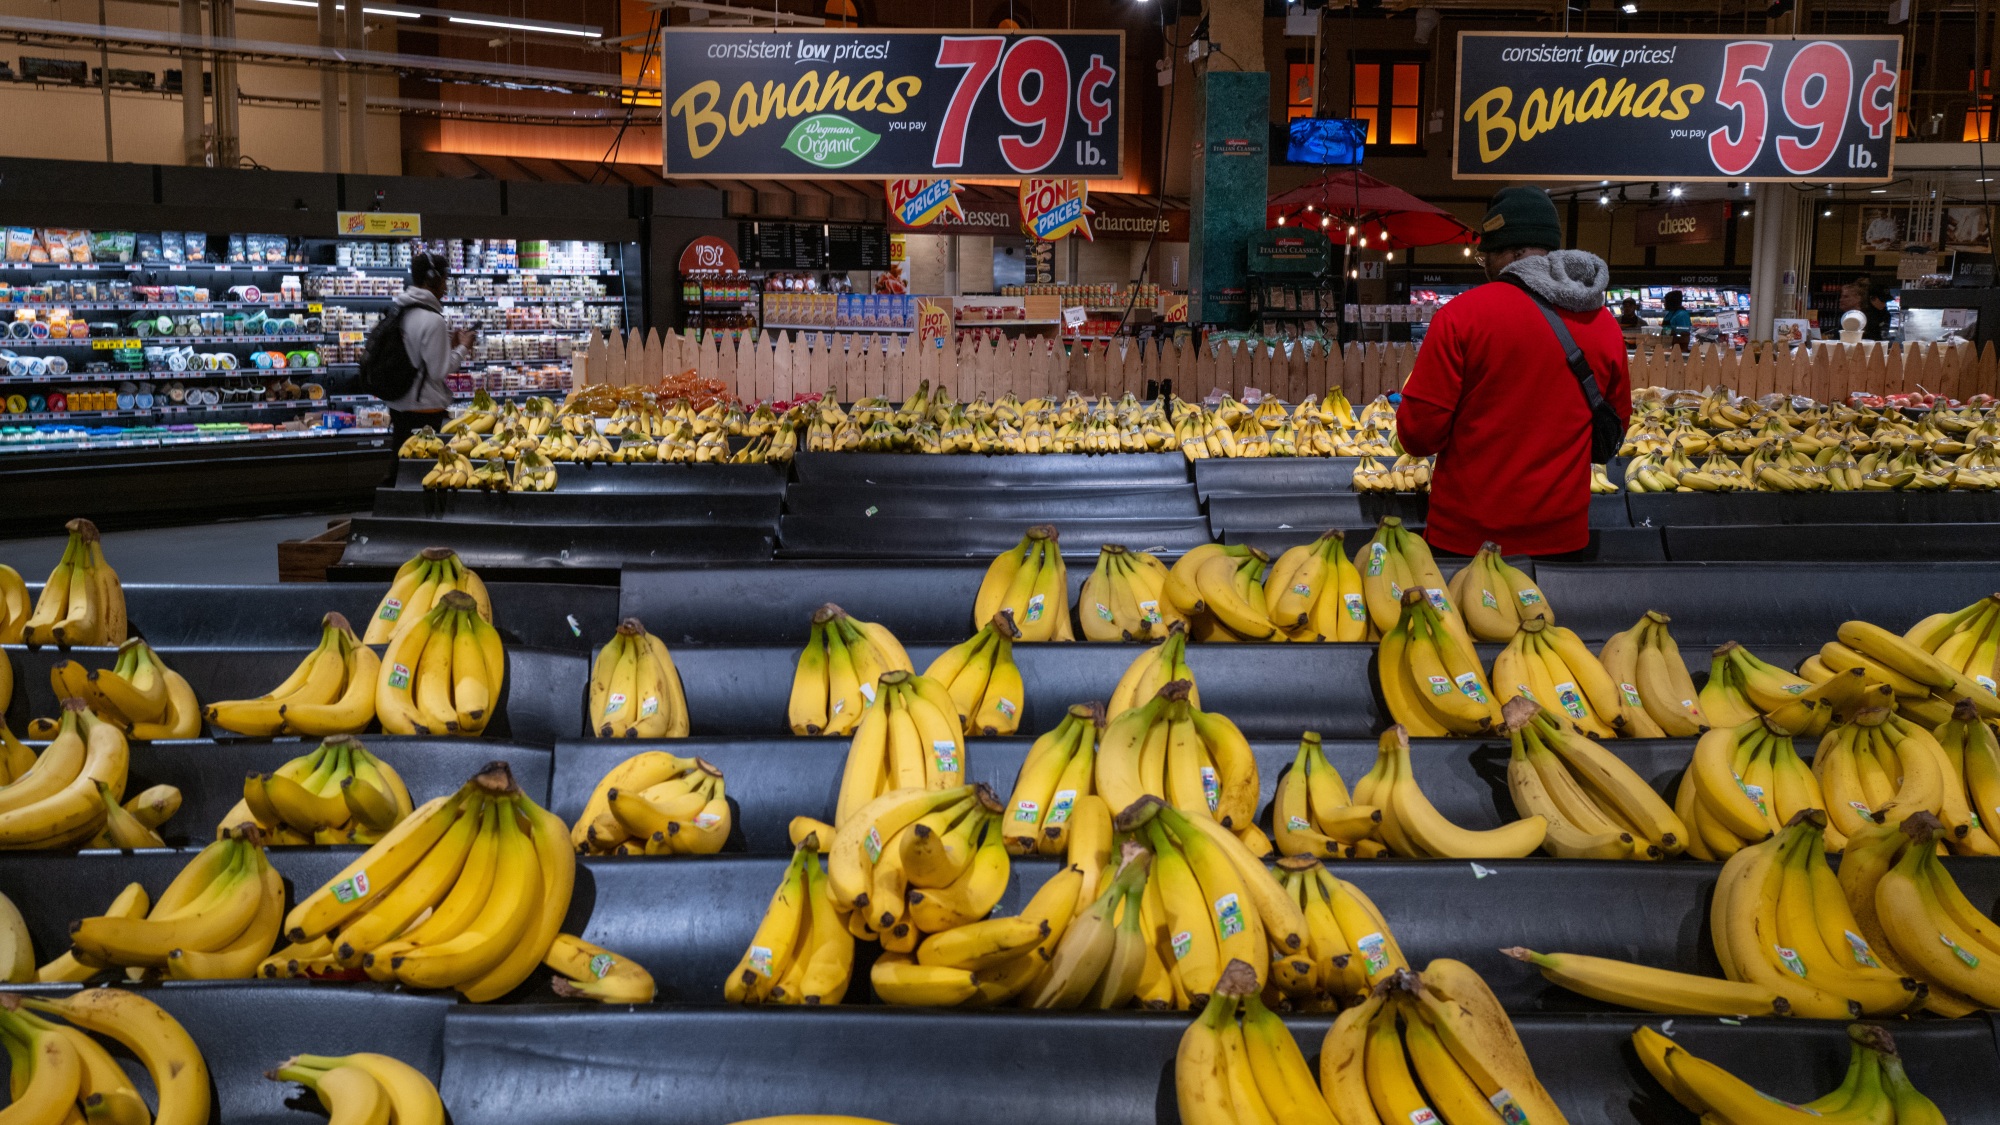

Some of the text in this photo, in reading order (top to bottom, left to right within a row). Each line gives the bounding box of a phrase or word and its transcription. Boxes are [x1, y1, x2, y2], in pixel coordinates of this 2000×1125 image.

[707, 39, 890, 64] consistent low prices!
[1501, 43, 1677, 68] consistent low prices!
[670, 69, 923, 160] Bananas
[888, 120, 927, 132] you pay
[1463, 77, 1706, 164] Bananas
[803, 121, 855, 137] Wegmans
[1670, 129, 1707, 140] you pay
[797, 134, 862, 161] Organic
[1075, 141, 1107, 166] lb.
[1848, 144, 1878, 169] lb.
[891, 179, 929, 213] ZO
[906, 179, 950, 221] PRICES
[1024, 179, 1079, 224] ZONE
[1039, 198, 1081, 234] PRICES
[1094, 211, 1170, 234] charcuterie
[1657, 212, 1697, 236] cheese
[1259, 246, 1287, 254] ITALIAN
[1680, 276, 1719, 284] HOT DOGS
[924, 313, 945, 326] HOT
[1167, 304, 1188, 322] HOT
[1021, 802, 1036, 810] Dole
[355, 874, 367, 893] Dole
[1173, 933, 1189, 944] Dole
[1415, 1110, 1434, 1124] Dole
